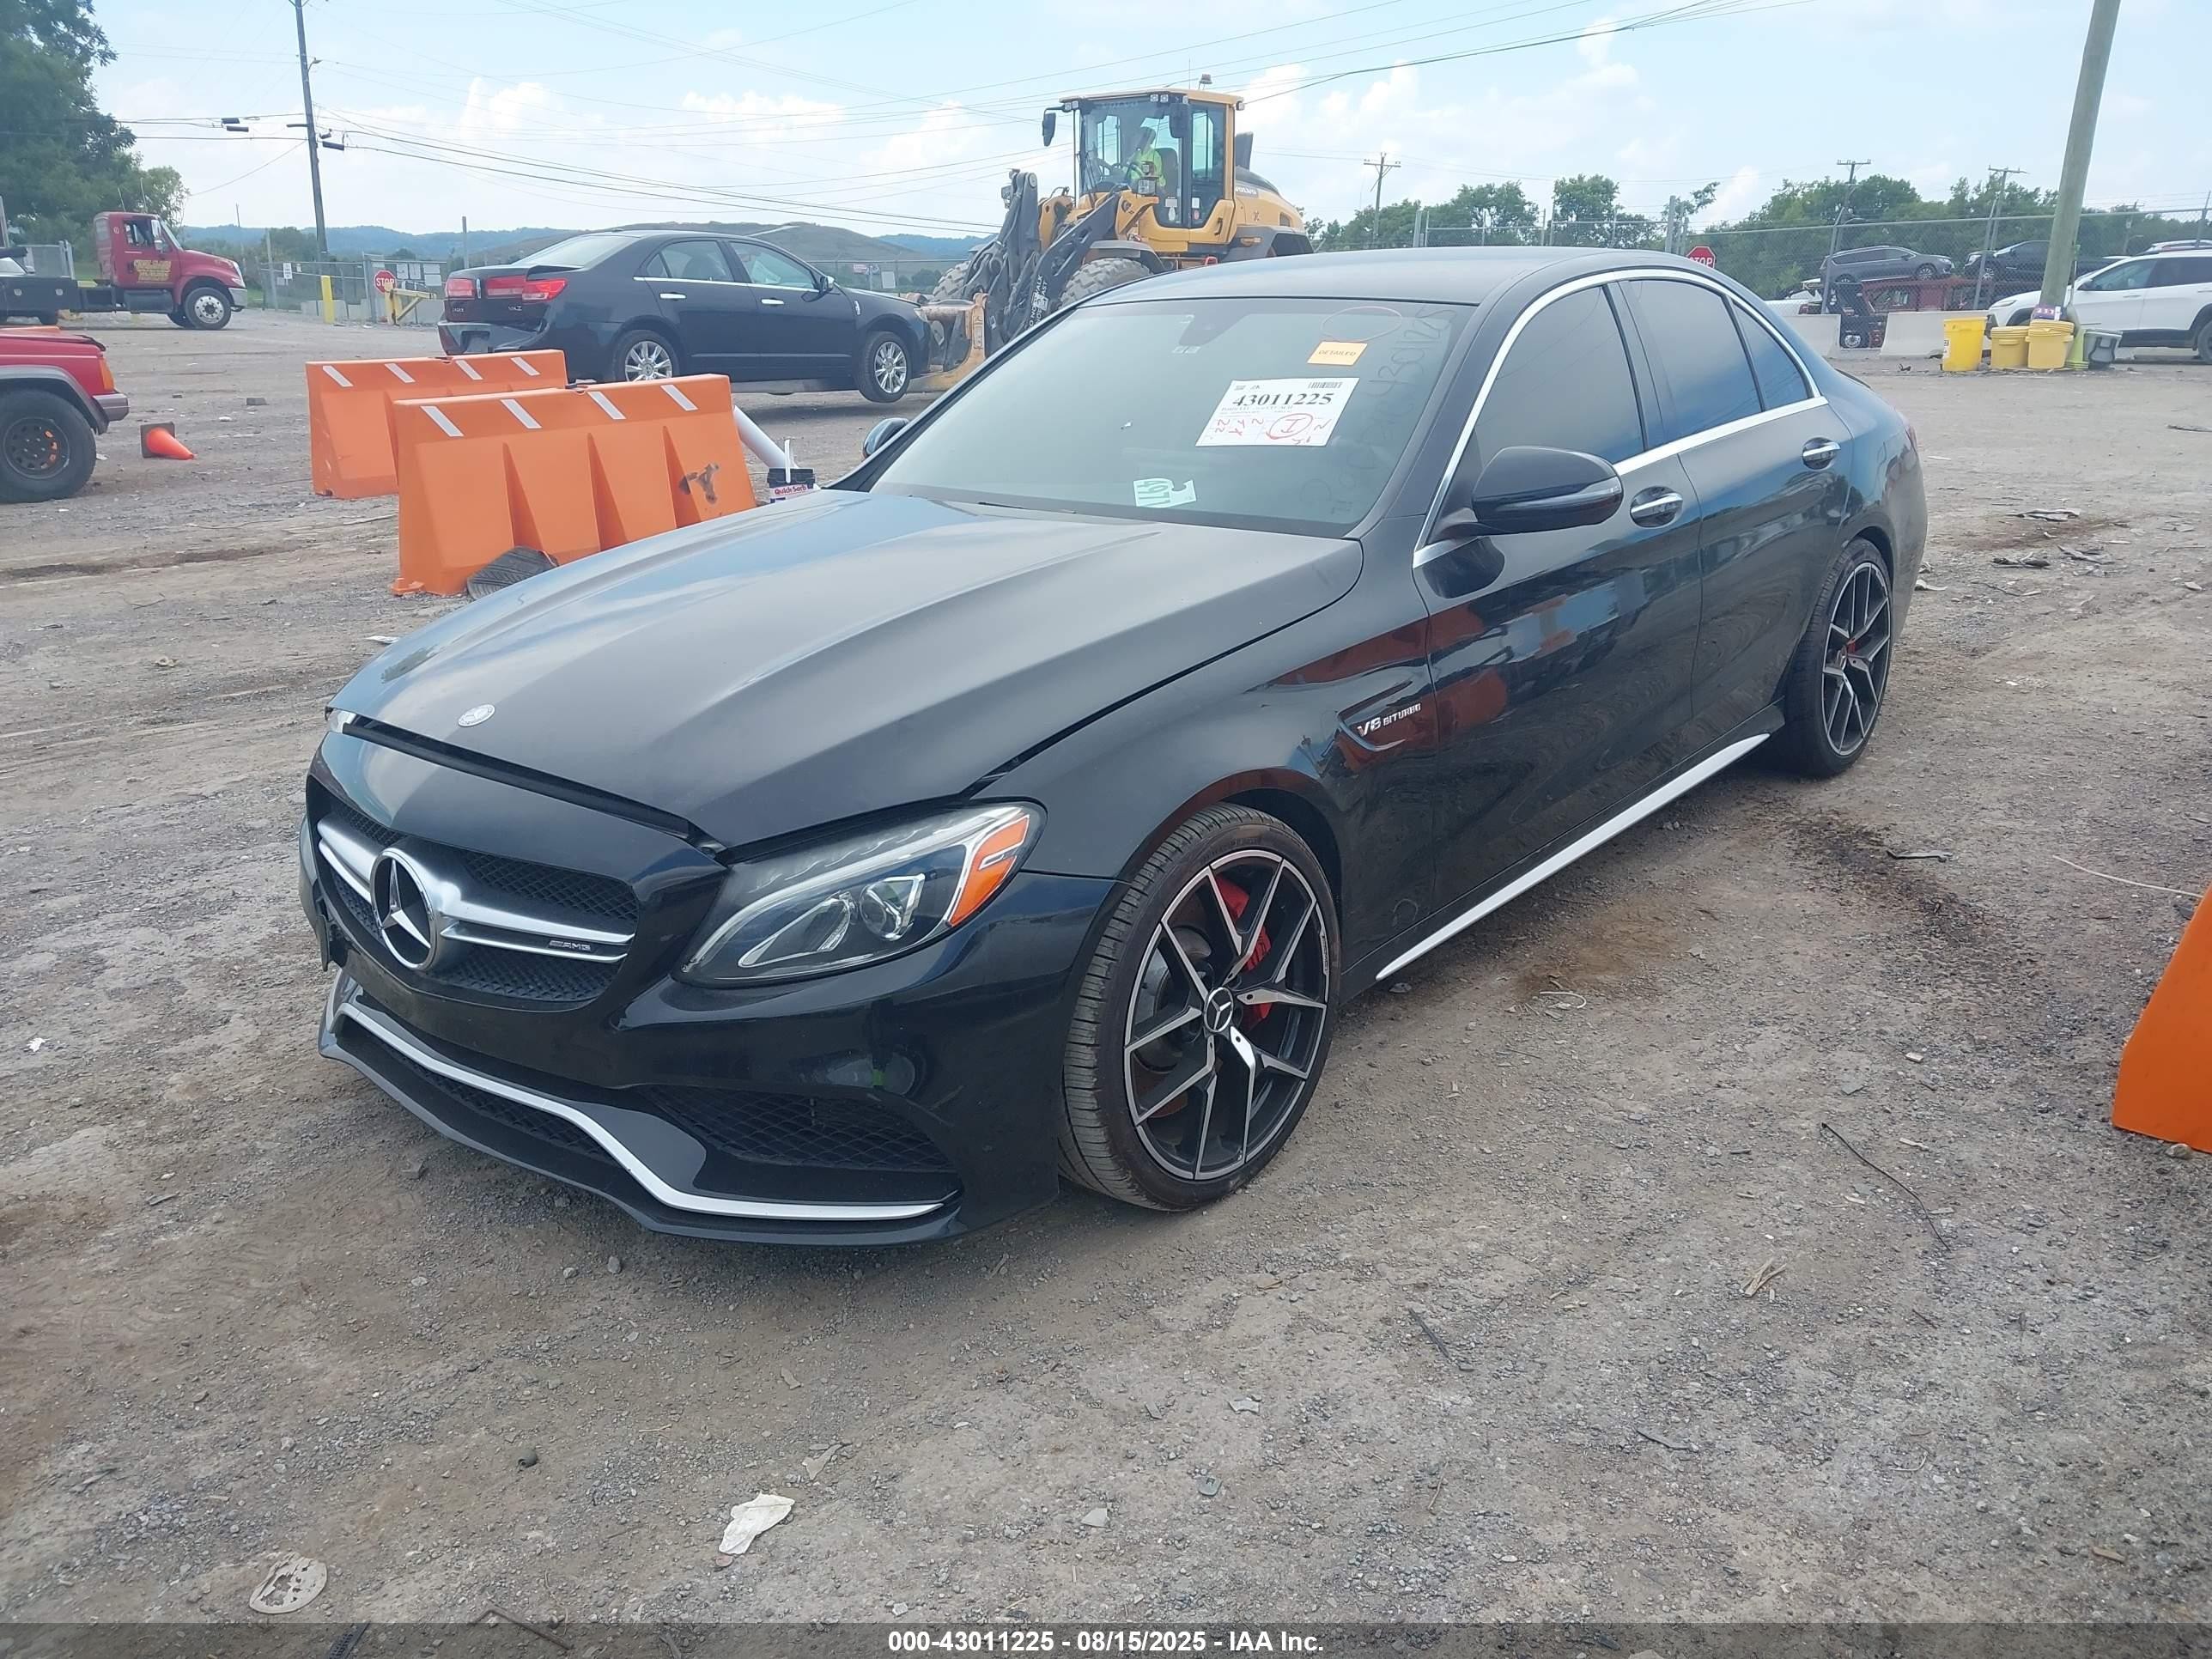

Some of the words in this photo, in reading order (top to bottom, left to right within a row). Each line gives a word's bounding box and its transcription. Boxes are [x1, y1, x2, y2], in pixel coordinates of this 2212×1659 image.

[1232, 392, 1334, 406] 43011225
[775, 487, 792, 495] Quick
[1382, 702, 1422, 726] BITURBO
[562, 941, 592, 951] AMG
